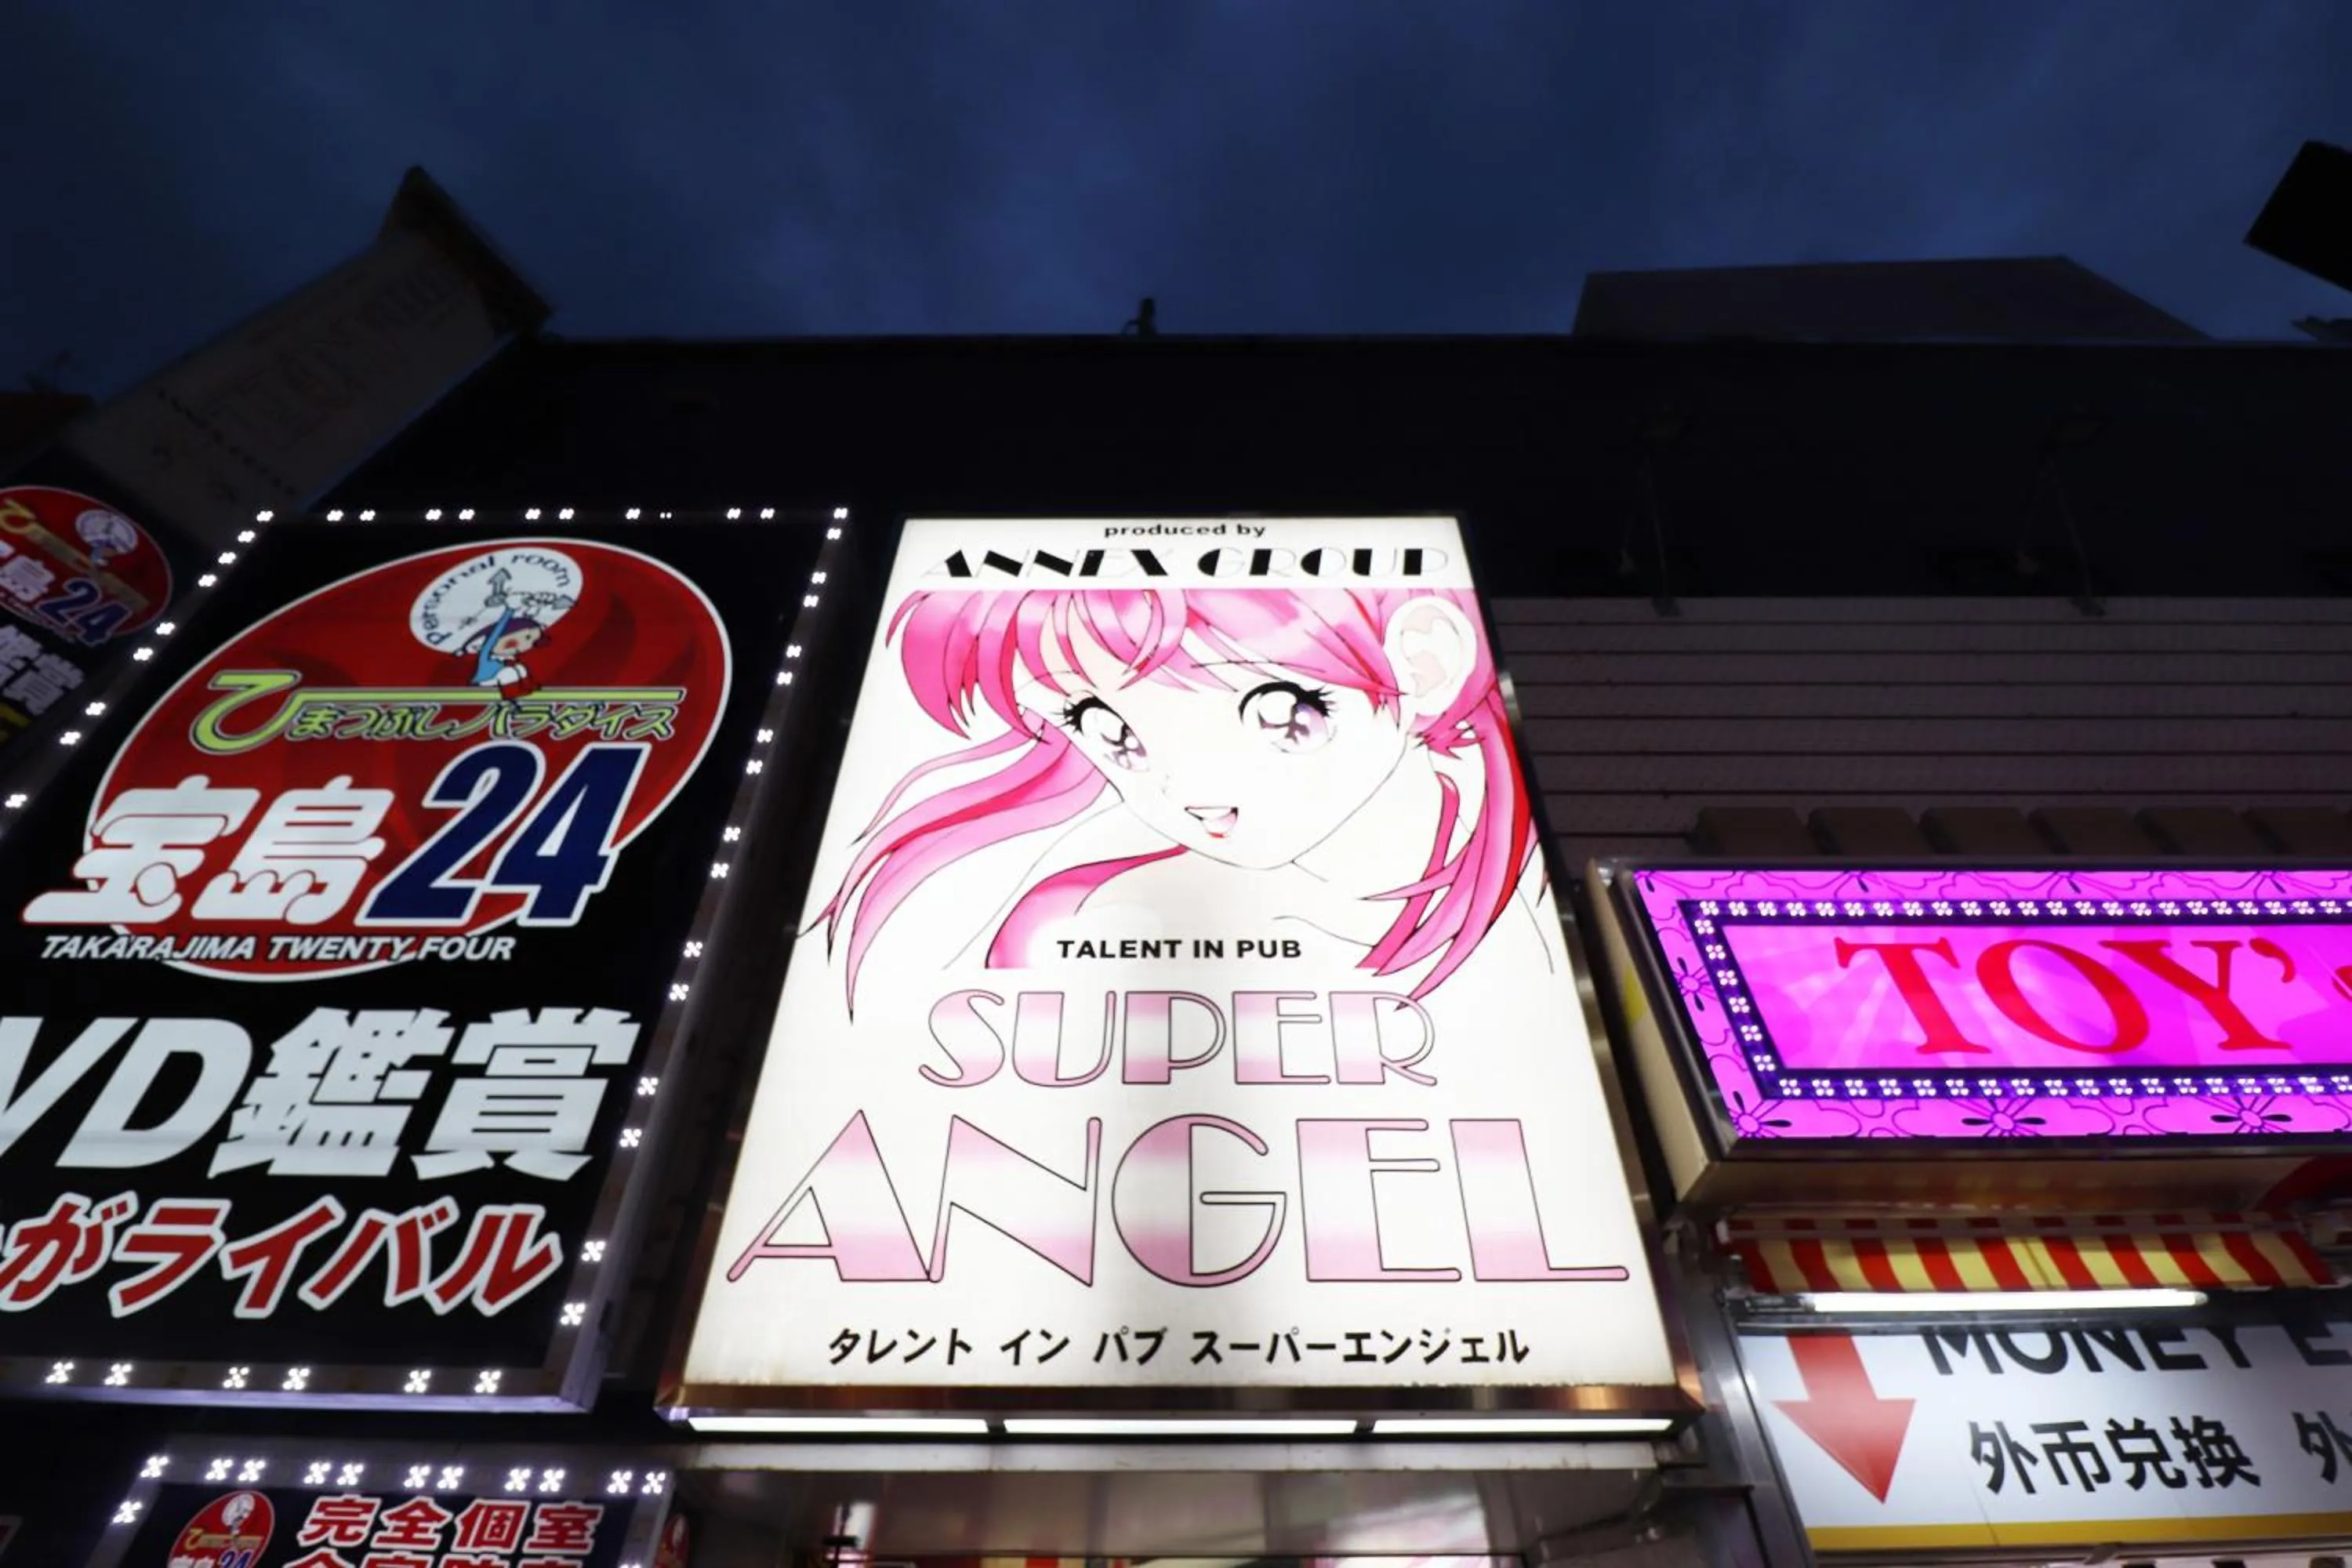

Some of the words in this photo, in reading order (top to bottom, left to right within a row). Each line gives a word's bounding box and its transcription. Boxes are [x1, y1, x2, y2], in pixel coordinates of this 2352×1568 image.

[1104, 524, 1227, 539] produced
[1236, 524, 1266, 539] by
[510, 554, 572, 588] room
[920, 546, 1174, 579] ANNEX
[1196, 546, 1449, 579] GROUP
[40, 935, 257, 961] TAKARAJIMA
[267, 935, 416, 961] TWENTY
[416, 935, 516, 961] FOUR
[1056, 939, 1182, 958] TALENT
[1192, 939, 1224, 958] IN
[1236, 939, 1301, 958] PUB
[1833, 936, 2352, 1054] TOY'
[918, 989, 1437, 1087] SUPER
[726, 1109, 1630, 1288] ANGEL
[829, 1327, 972, 1365] タレント
[1000, 1328, 1070, 1366] イン
[1093, 1325, 1168, 1365] パブ
[1190, 1326, 1530, 1365] スーパーエンジェル
[1968, 1415, 2261, 1494] 外币兑换
[296, 1494, 604, 1555] 完全個室
